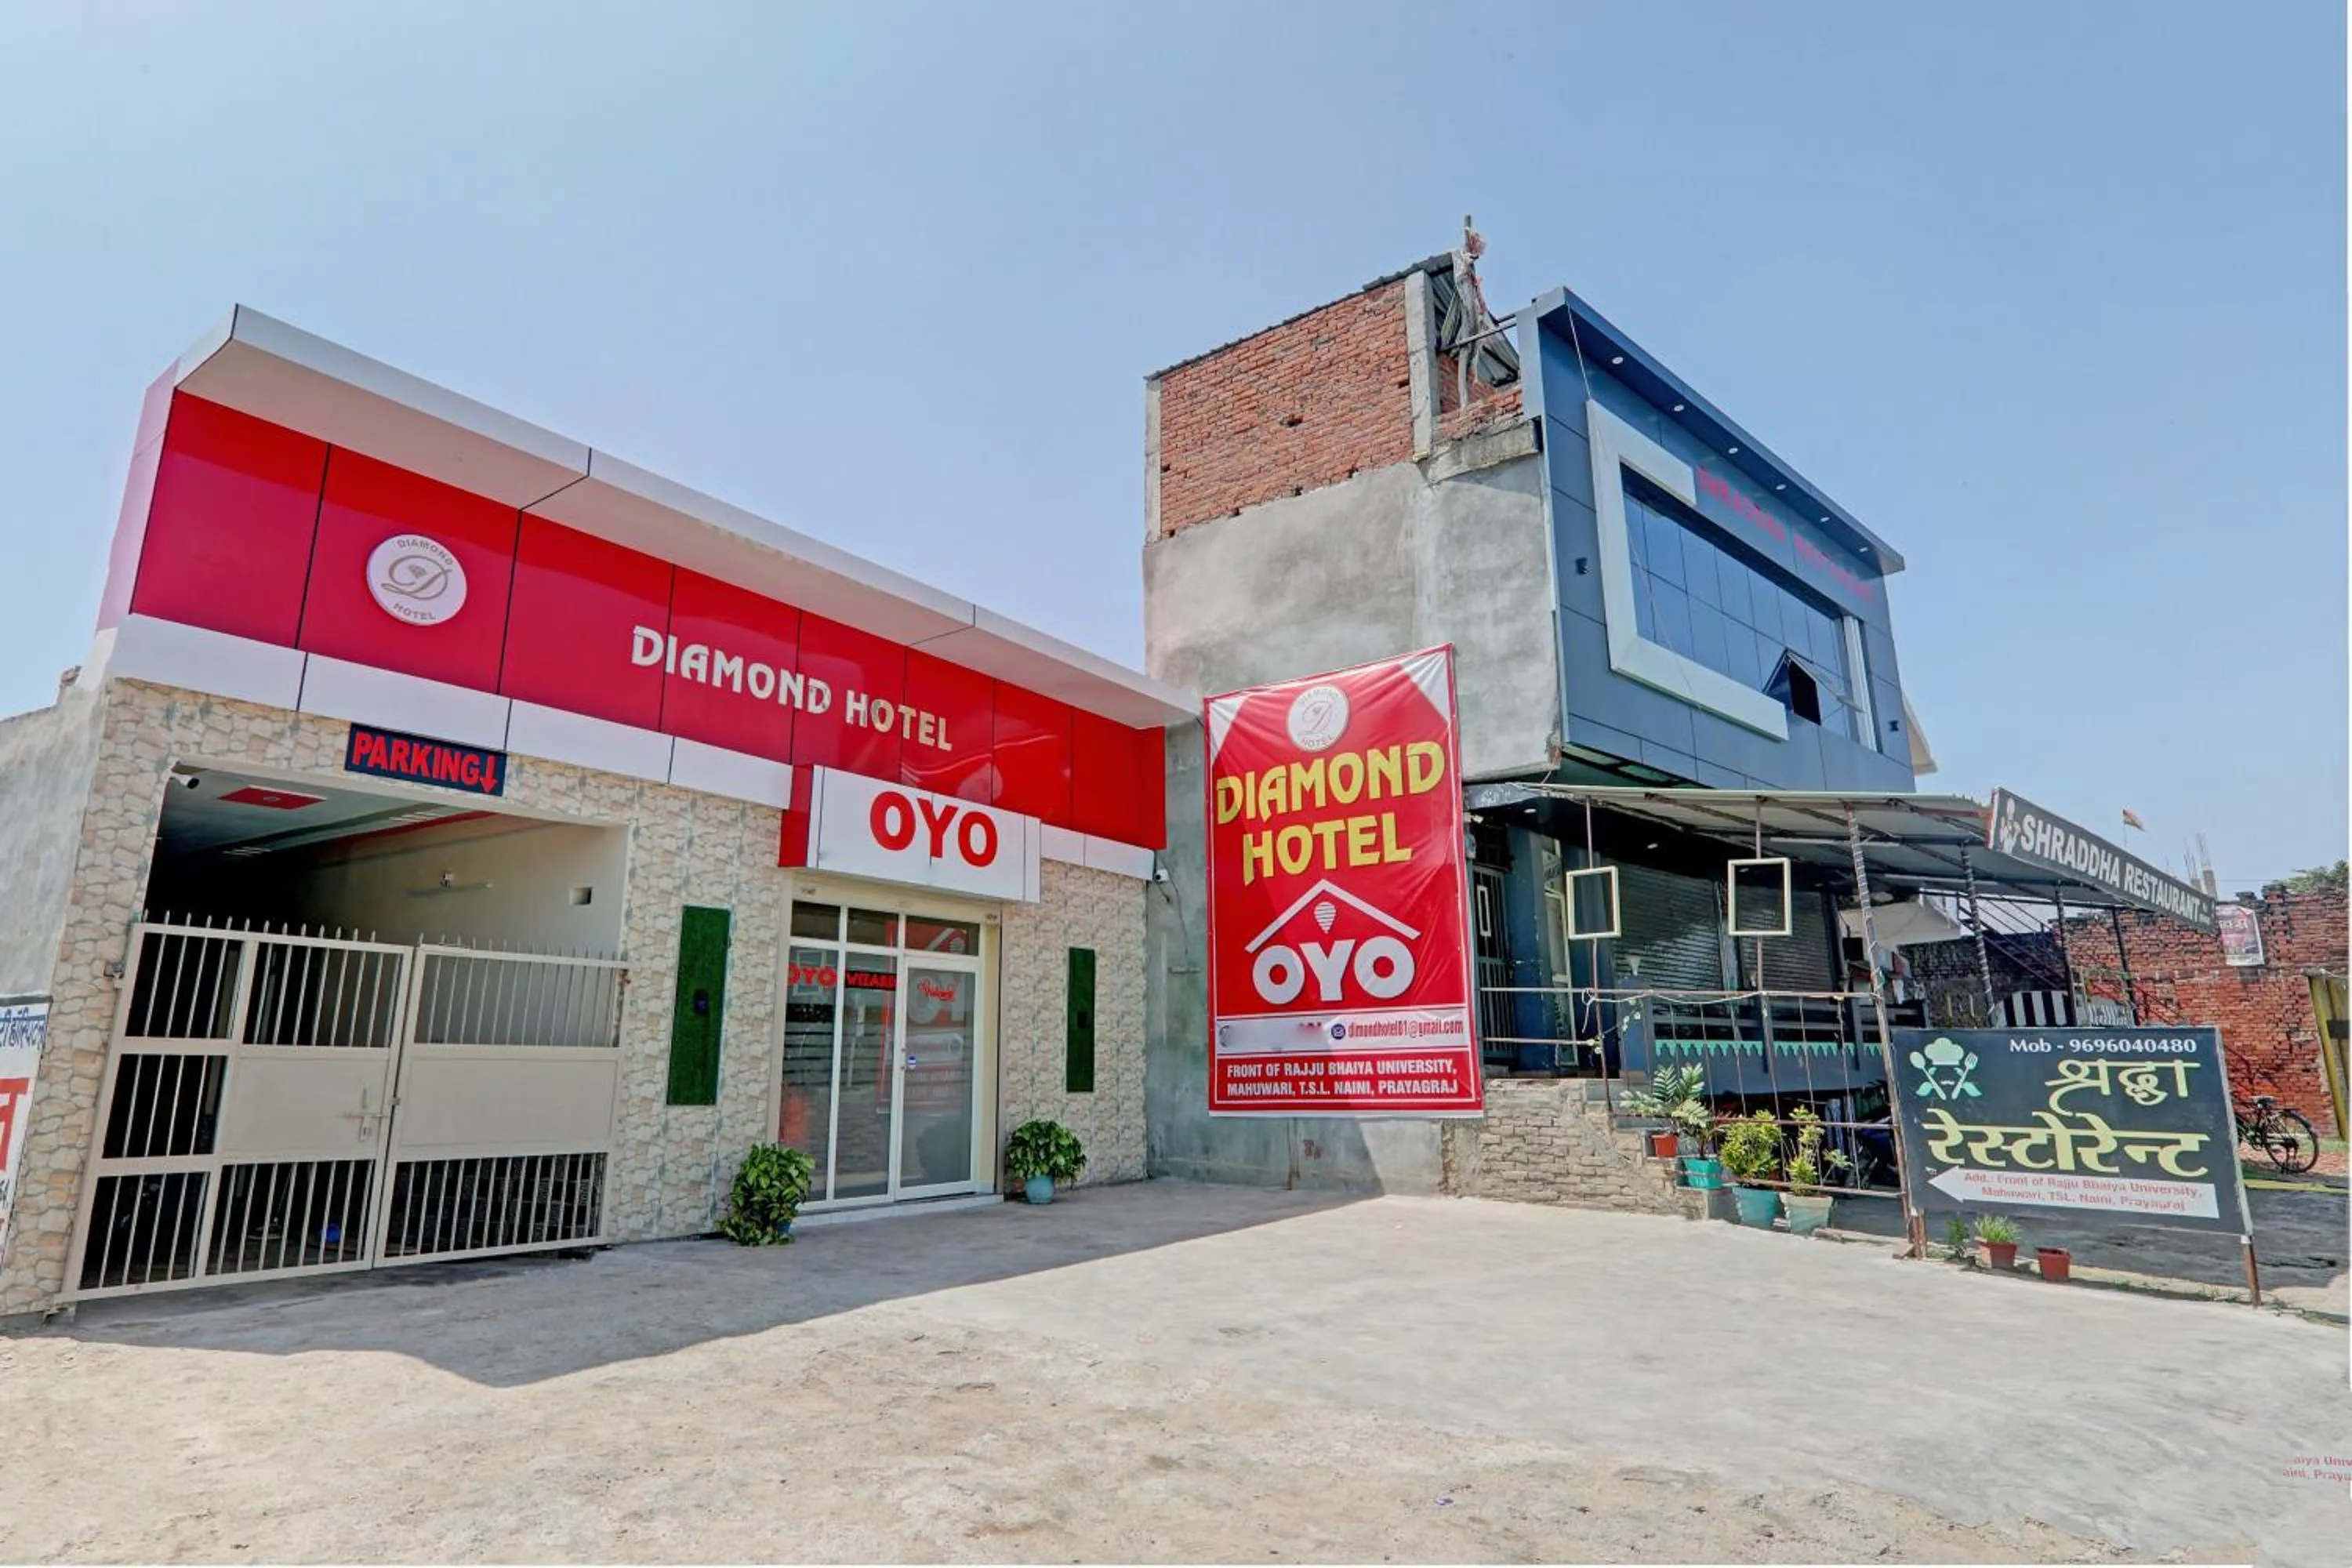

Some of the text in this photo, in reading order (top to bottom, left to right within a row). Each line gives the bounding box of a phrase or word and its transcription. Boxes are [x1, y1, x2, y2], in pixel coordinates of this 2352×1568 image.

[397, 539, 453, 565] DIAMOND
[394, 602, 437, 620] HOTEL
[630, 626, 953, 751] DIAMOND HOTEL
[352, 730, 481, 786] PARKING
[1216, 741, 1445, 824] DIAMOND
[869, 791, 998, 867] OYO
[1243, 812, 1412, 886] HOTEL
[2020, 814, 2201, 923] SHRADDHA RESTAURANT
[1252, 935, 1415, 1004] OYO
[1227, 1058, 1457, 1077] FRONT OF RAJJU BHAIYA UNIVERSITY,
[2009, 1038, 2052, 1053] Mob
[2069, 1039, 2198, 1053] 9696040480
[1377, 1079, 1458, 1094] PRAYAGRAJ
[2045, 1058, 2201, 1116] श्रद्धा
[1997, 1174, 2028, 1185] Front
[2032, 1177, 2043, 1186] of
[2048, 1178, 2078, 1189] Rajju
[2082, 1179, 2126, 1192] Bhaiya
